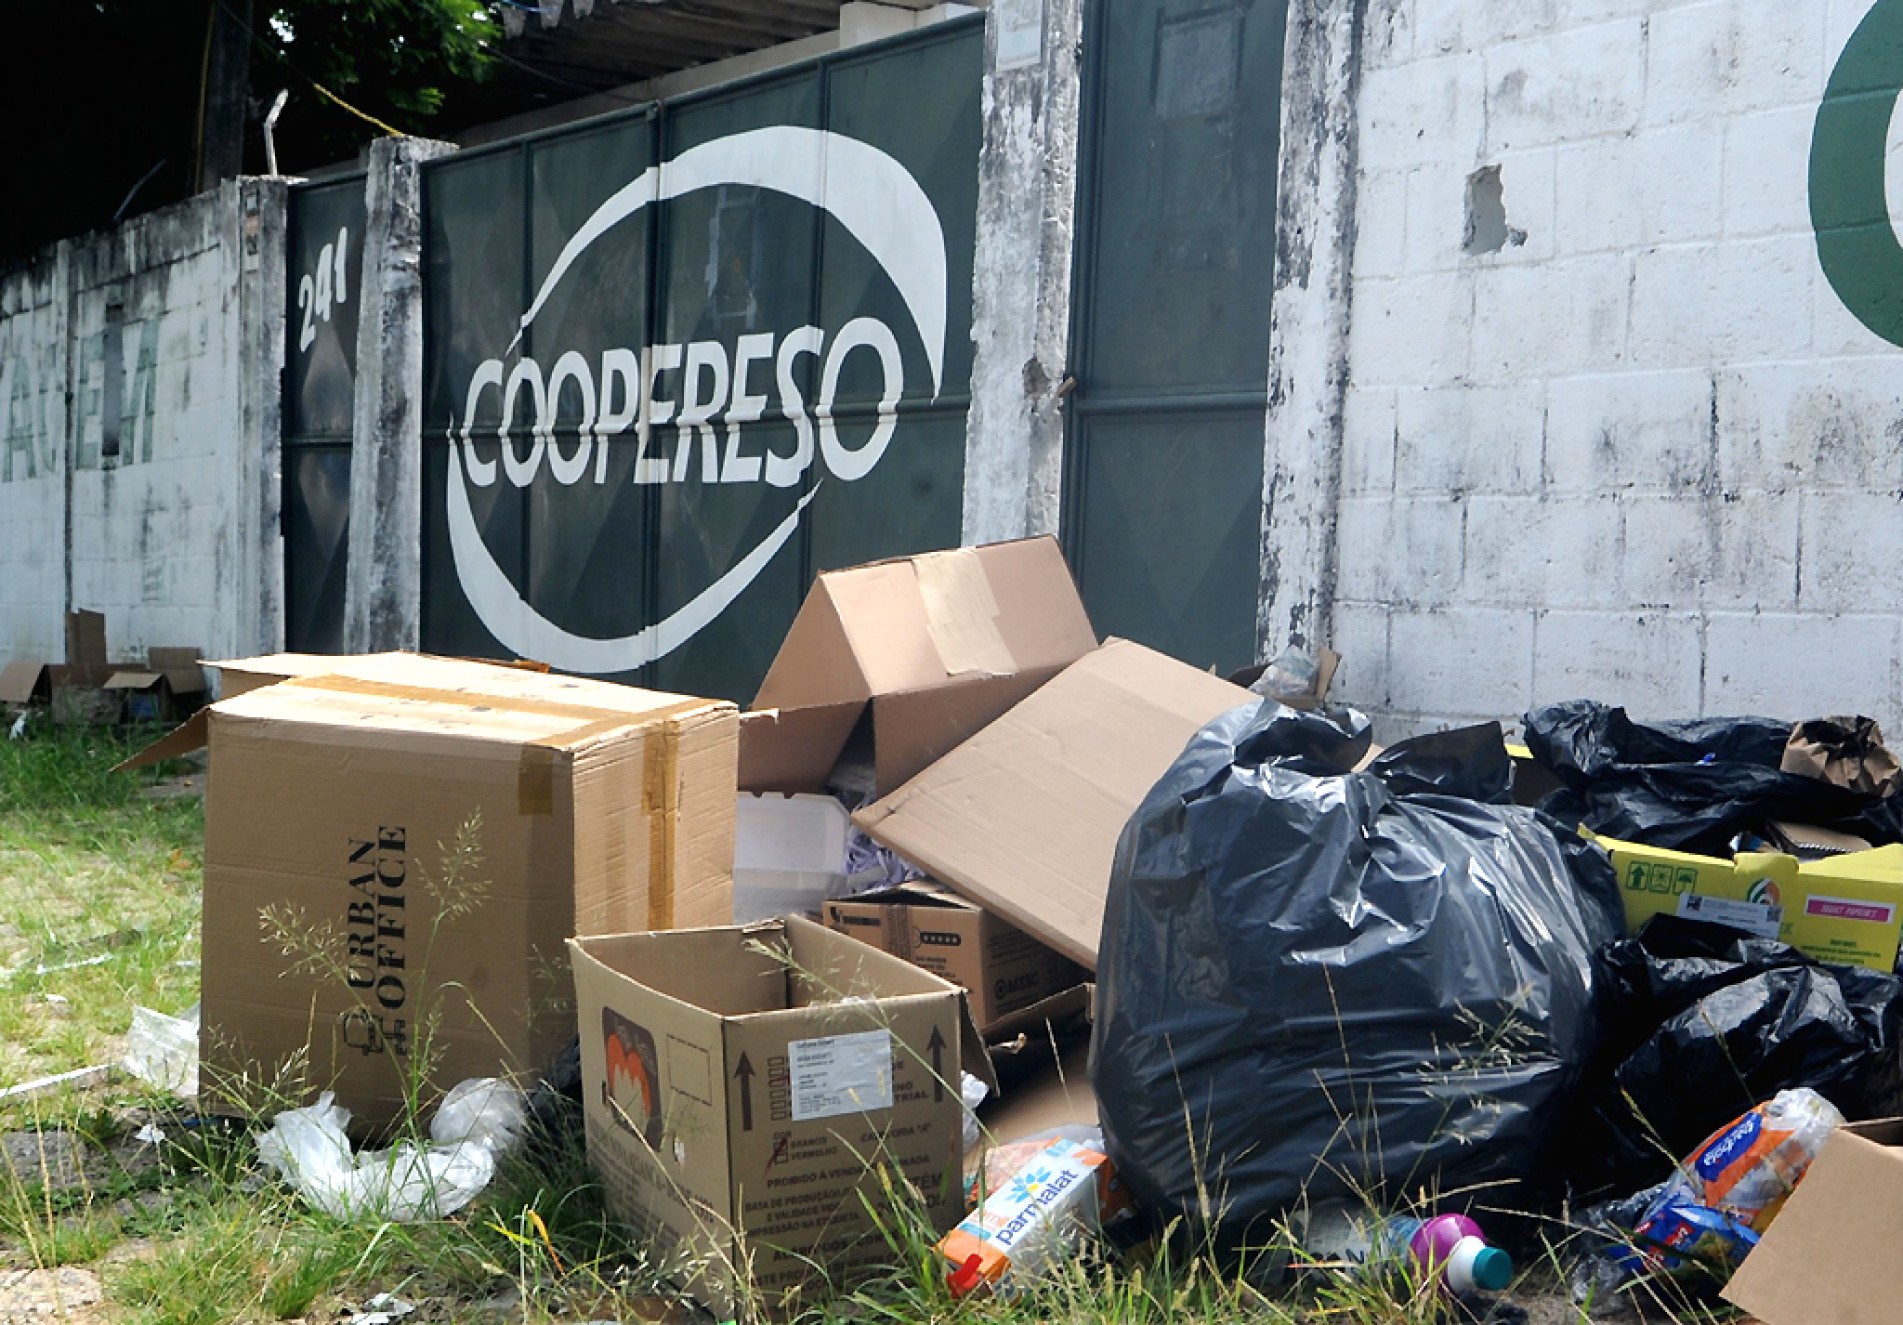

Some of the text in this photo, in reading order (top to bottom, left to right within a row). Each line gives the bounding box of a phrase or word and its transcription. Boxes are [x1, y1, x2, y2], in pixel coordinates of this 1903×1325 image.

[298, 226, 347, 352] 241
[461, 317, 904, 488] COOPERESO
[347, 838, 377, 989] URBAN
[376, 826, 407, 1010] OFFICE
